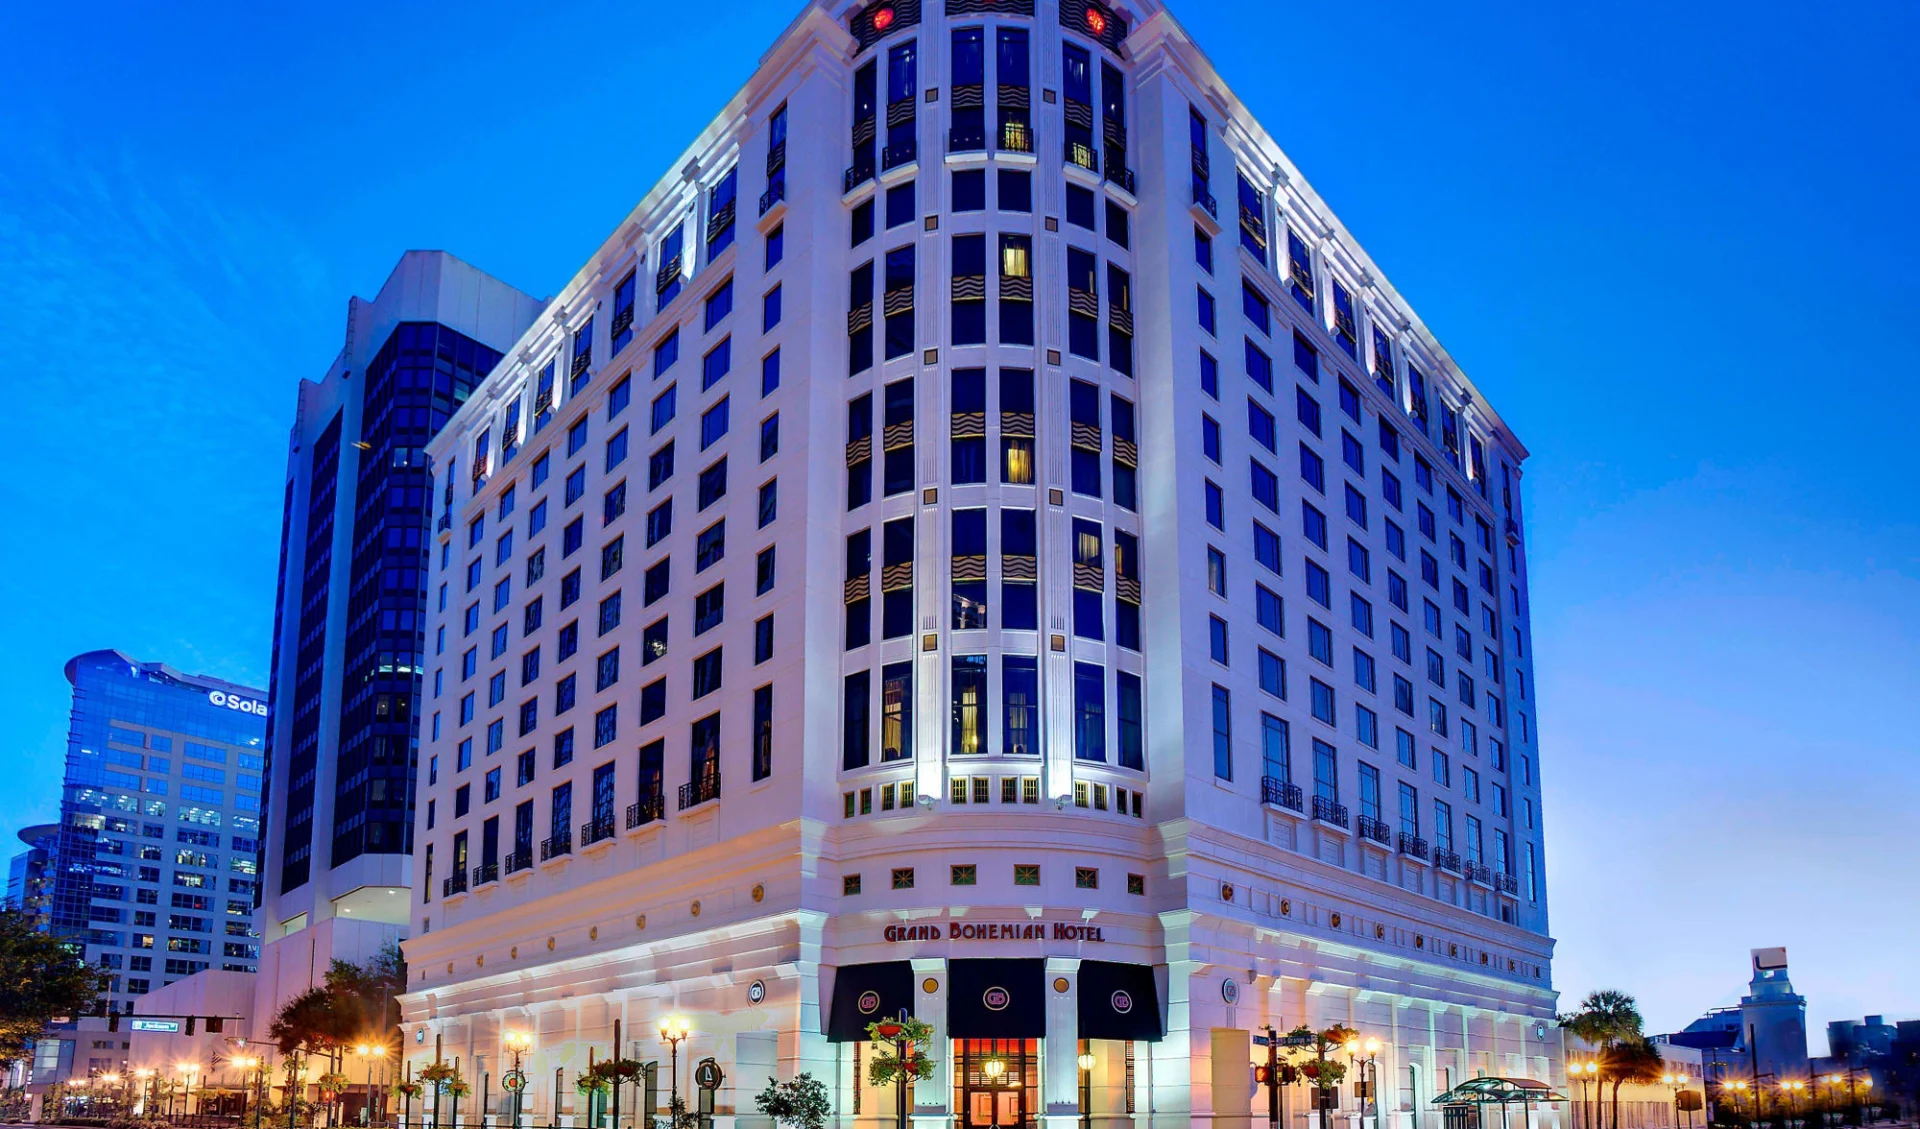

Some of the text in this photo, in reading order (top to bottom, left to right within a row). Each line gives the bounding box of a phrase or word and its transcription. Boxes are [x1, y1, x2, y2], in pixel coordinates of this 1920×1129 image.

[884, 922, 1105, 942] GRAND BOHEMIAN HOTEL
